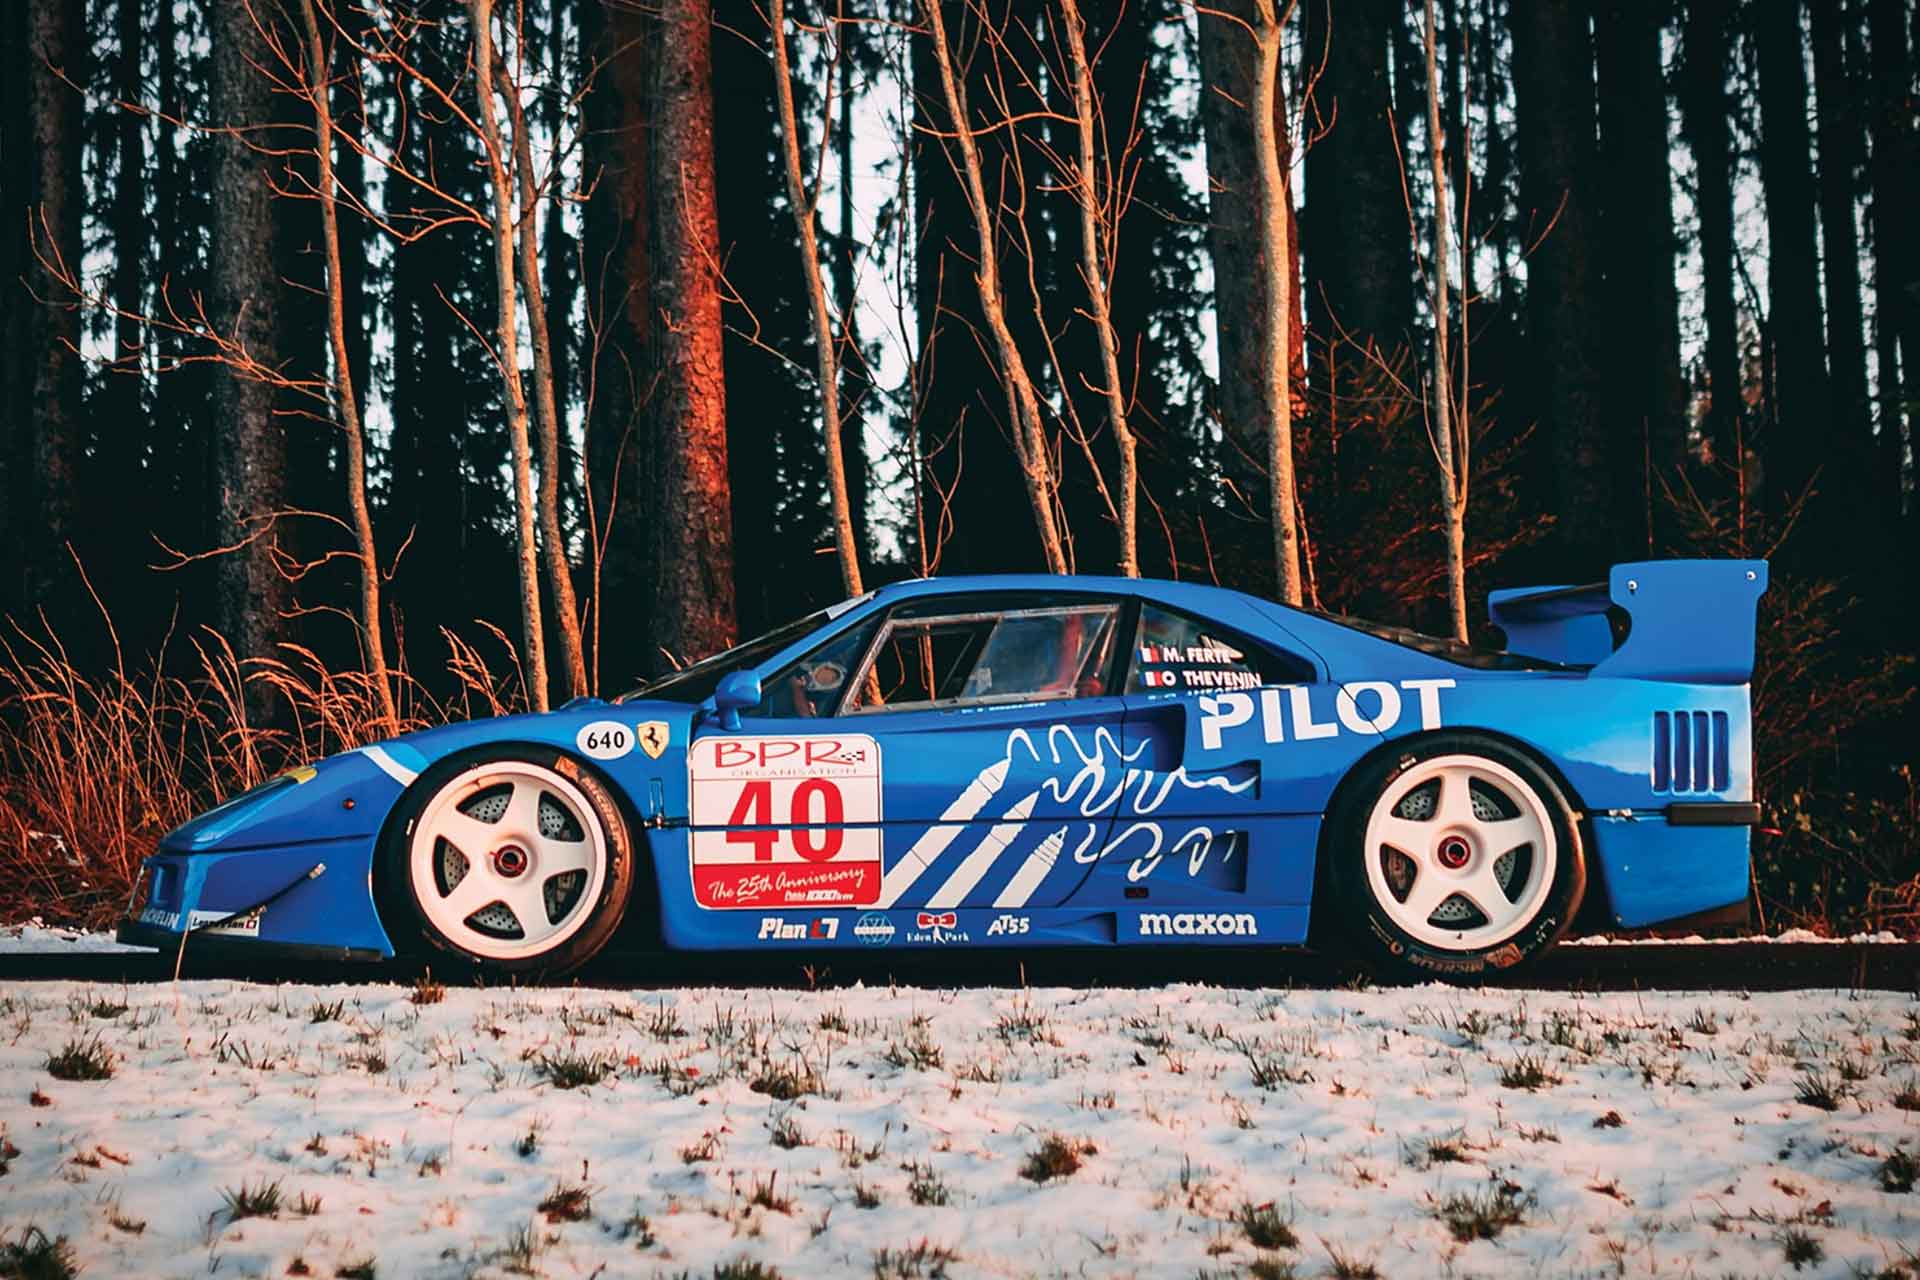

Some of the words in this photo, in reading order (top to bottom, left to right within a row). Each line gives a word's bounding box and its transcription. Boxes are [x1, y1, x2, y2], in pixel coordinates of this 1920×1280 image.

[1163, 647, 1185, 662] M.
[1182, 670, 1262, 688] THEVENIN
[1199, 678, 1457, 750] PILOT
[587, 731, 625, 750] 640
[715, 741, 854, 768] BPR
[725, 777, 844, 862] 40
[708, 880, 735, 902] The
[736, 873, 773, 901] 25th
[775, 867, 865, 890] Anniversary
[758, 917, 807, 939] Plan
[986, 914, 1030, 936] AT55
[1139, 913, 1258, 935] maxon
[944, 931, 970, 942] Park
